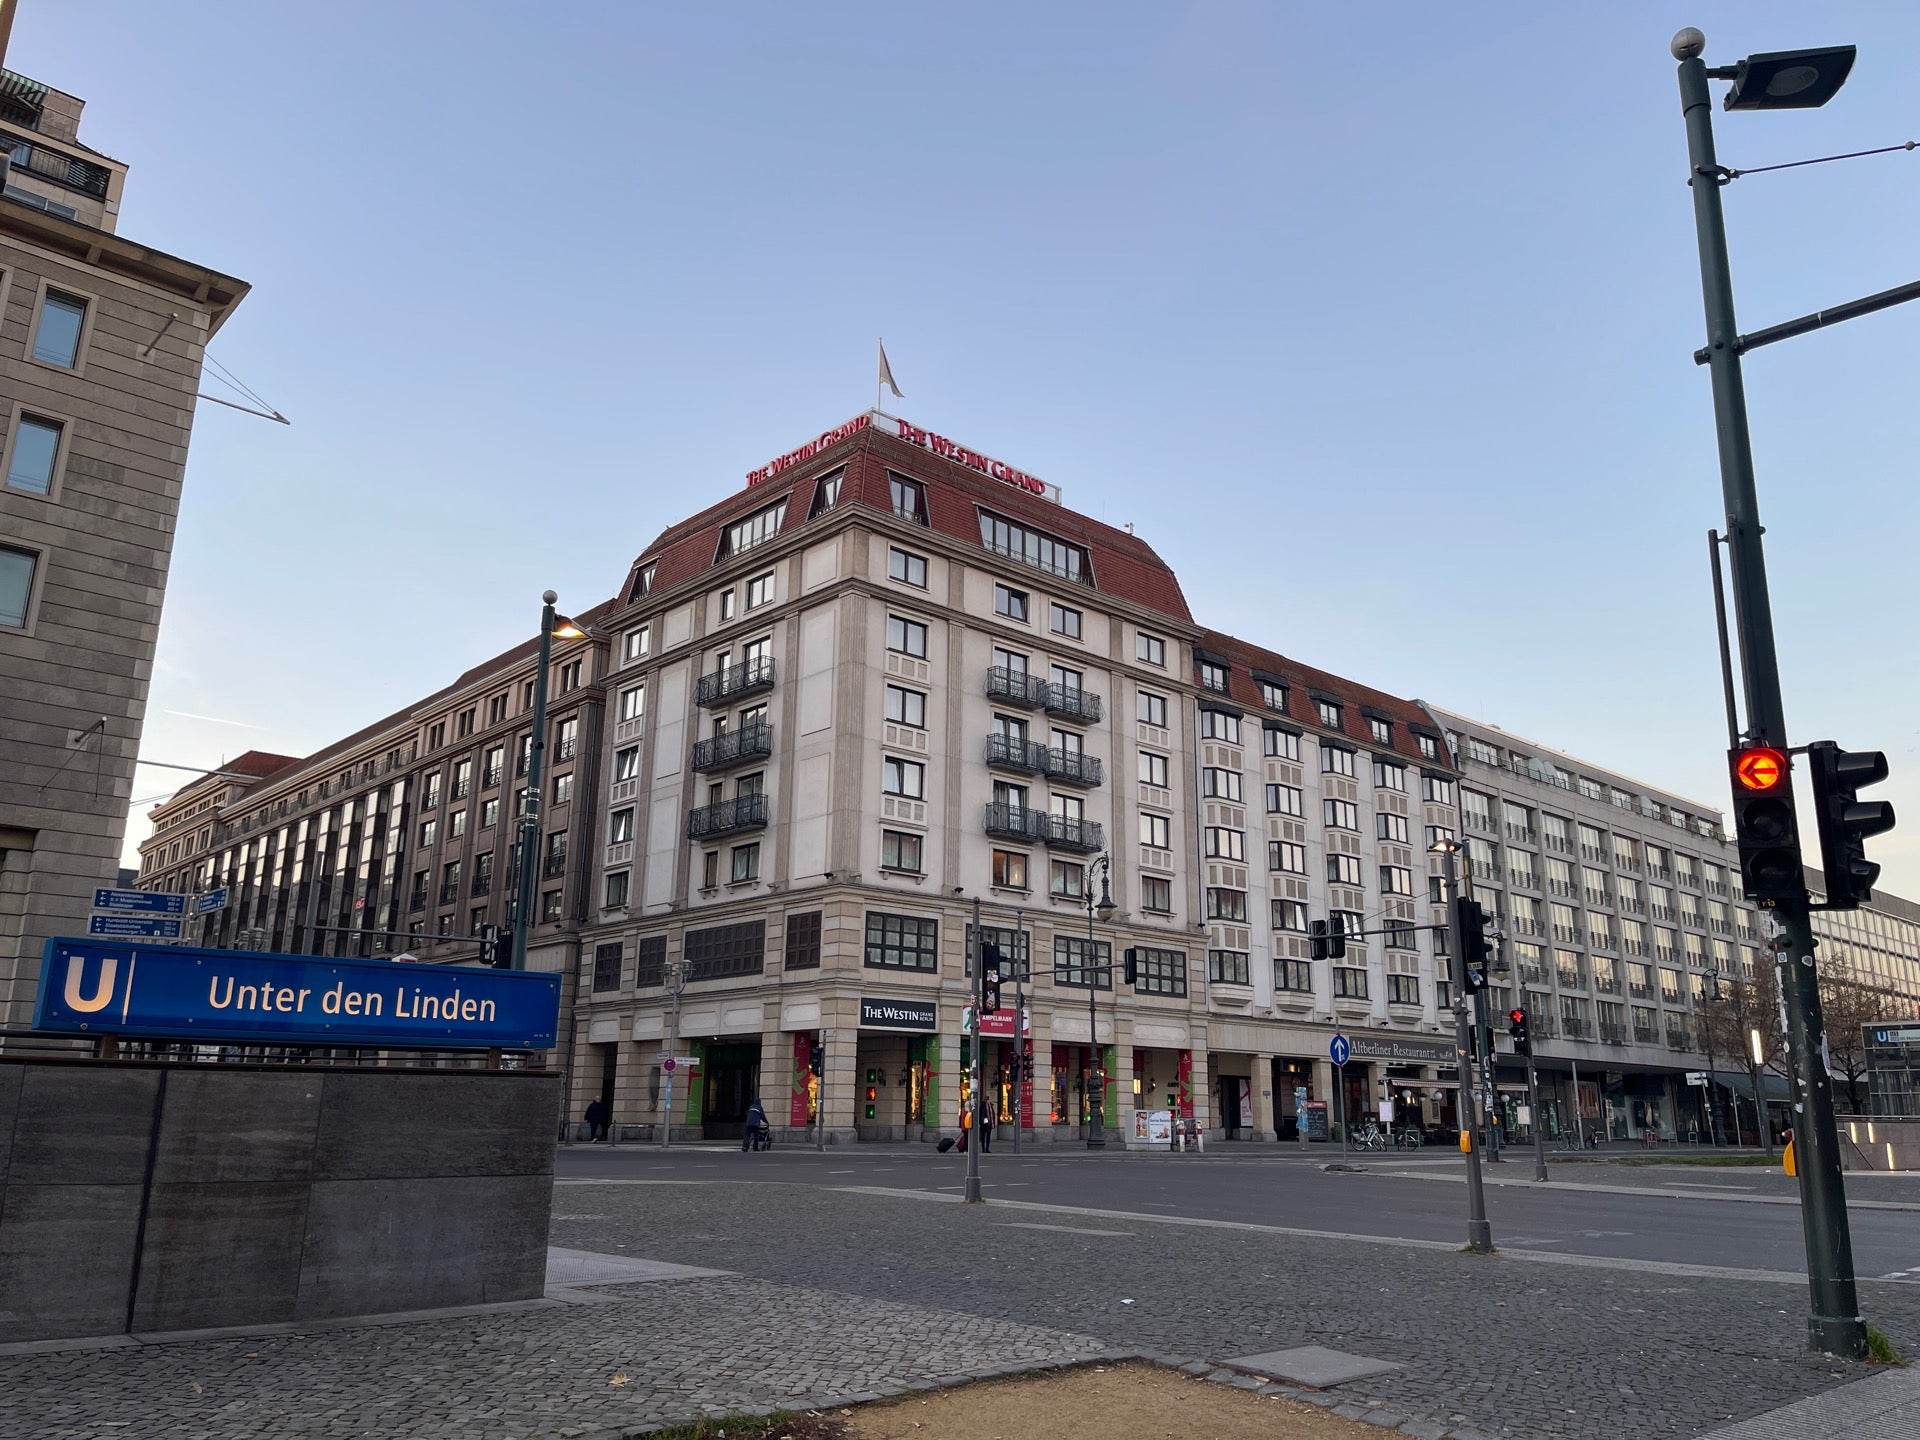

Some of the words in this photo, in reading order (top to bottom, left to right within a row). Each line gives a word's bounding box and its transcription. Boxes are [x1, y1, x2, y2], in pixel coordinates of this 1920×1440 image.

[745, 467, 768, 488] THE
[770, 440, 818, 474] WESTIN
[818, 415, 870, 451] GRAND
[897, 418, 927, 447] THE
[928, 431, 989, 472] WESTIN
[990, 461, 1047, 495] GRAND
[63, 956, 118, 1013] U
[208, 975, 311, 1015] Unter
[322, 981, 383, 1016] den
[395, 987, 496, 1022] Linden
[864, 1005, 883, 1018] THE
[883, 1006, 919, 1021] WESTIN
[982, 1014, 1013, 1022] AMPELMANN
[1351, 1040, 1391, 1055] Altberliner
[1393, 1043, 1430, 1058] Restaurant
[1877, 1031, 1887, 1042] U
